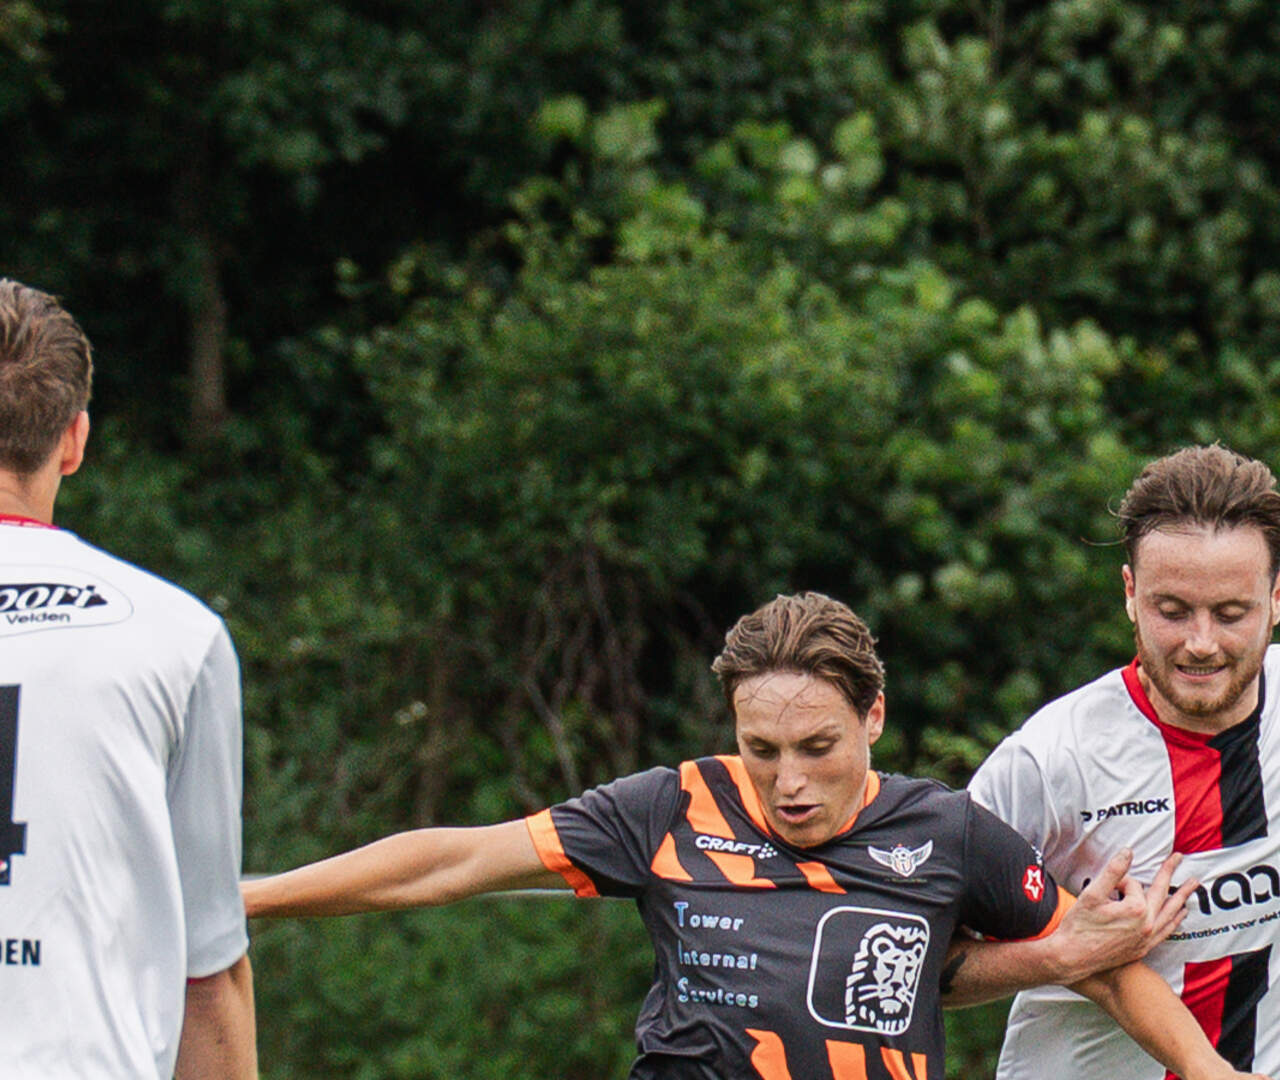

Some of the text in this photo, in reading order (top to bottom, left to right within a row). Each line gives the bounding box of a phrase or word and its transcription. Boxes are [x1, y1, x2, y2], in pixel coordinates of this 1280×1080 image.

[6, 611, 71, 625] Velden
[1096, 798, 1170, 821] PATRICK
[695, 835, 762, 855] CRAFT
[673, 901, 745, 931] Tower
[678, 939, 758, 970] Internal
